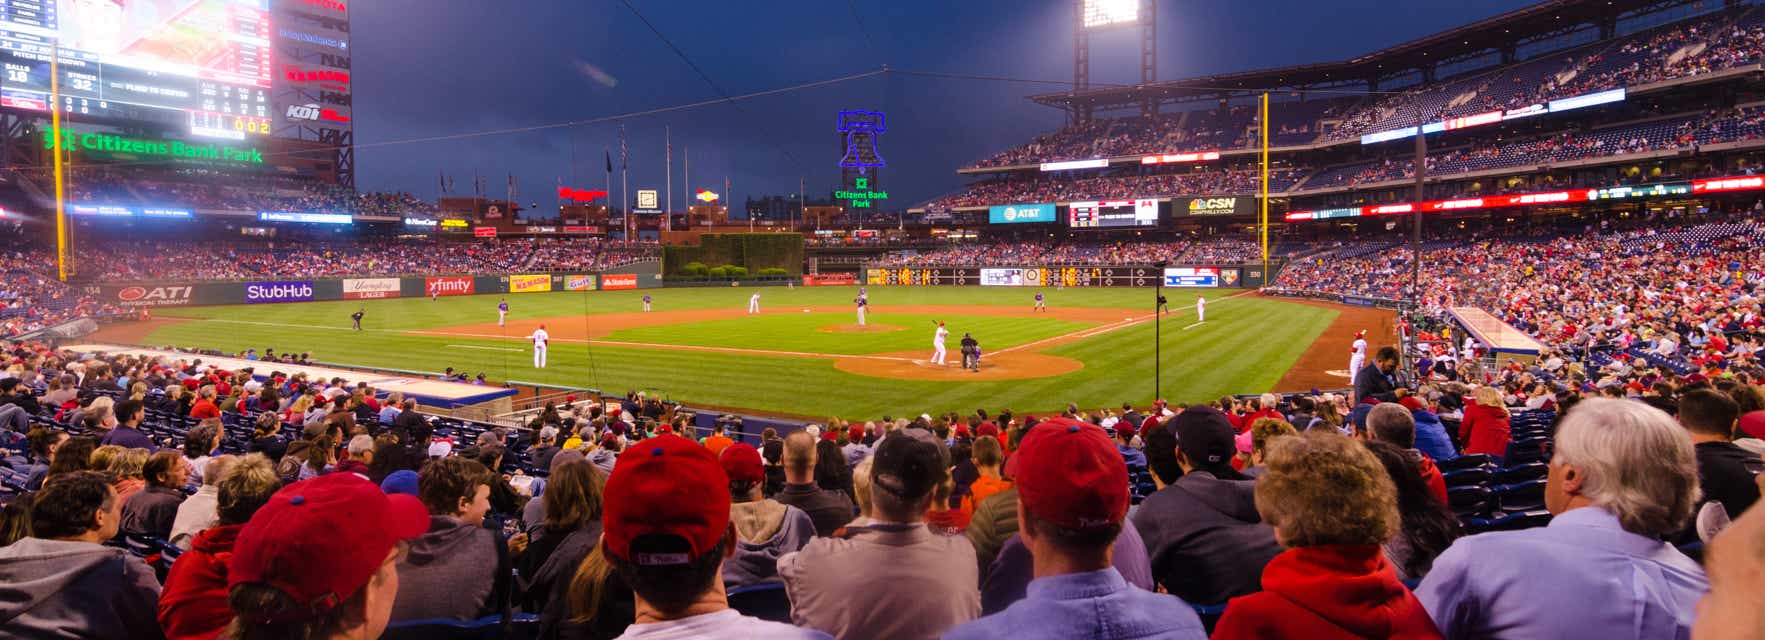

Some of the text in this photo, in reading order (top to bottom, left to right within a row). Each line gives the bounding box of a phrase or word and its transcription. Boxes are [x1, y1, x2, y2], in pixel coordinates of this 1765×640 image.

[6, 64, 30, 73] BALLS
[8, 70, 28, 83] 18
[72, 78, 93, 91] 32
[81, 132, 169, 156] Citizens
[172, 140, 219, 160] Bank
[223, 146, 263, 165] Park
[834, 190, 889, 199] Citizens Bank
[852, 200, 871, 208] Park
[1206, 198, 1236, 209] CSN
[1017, 208, 1040, 218] AT&T
[144, 286, 193, 299] ATI
[247, 284, 313, 301] StubHub
[430, 279, 470, 294] xfinity
